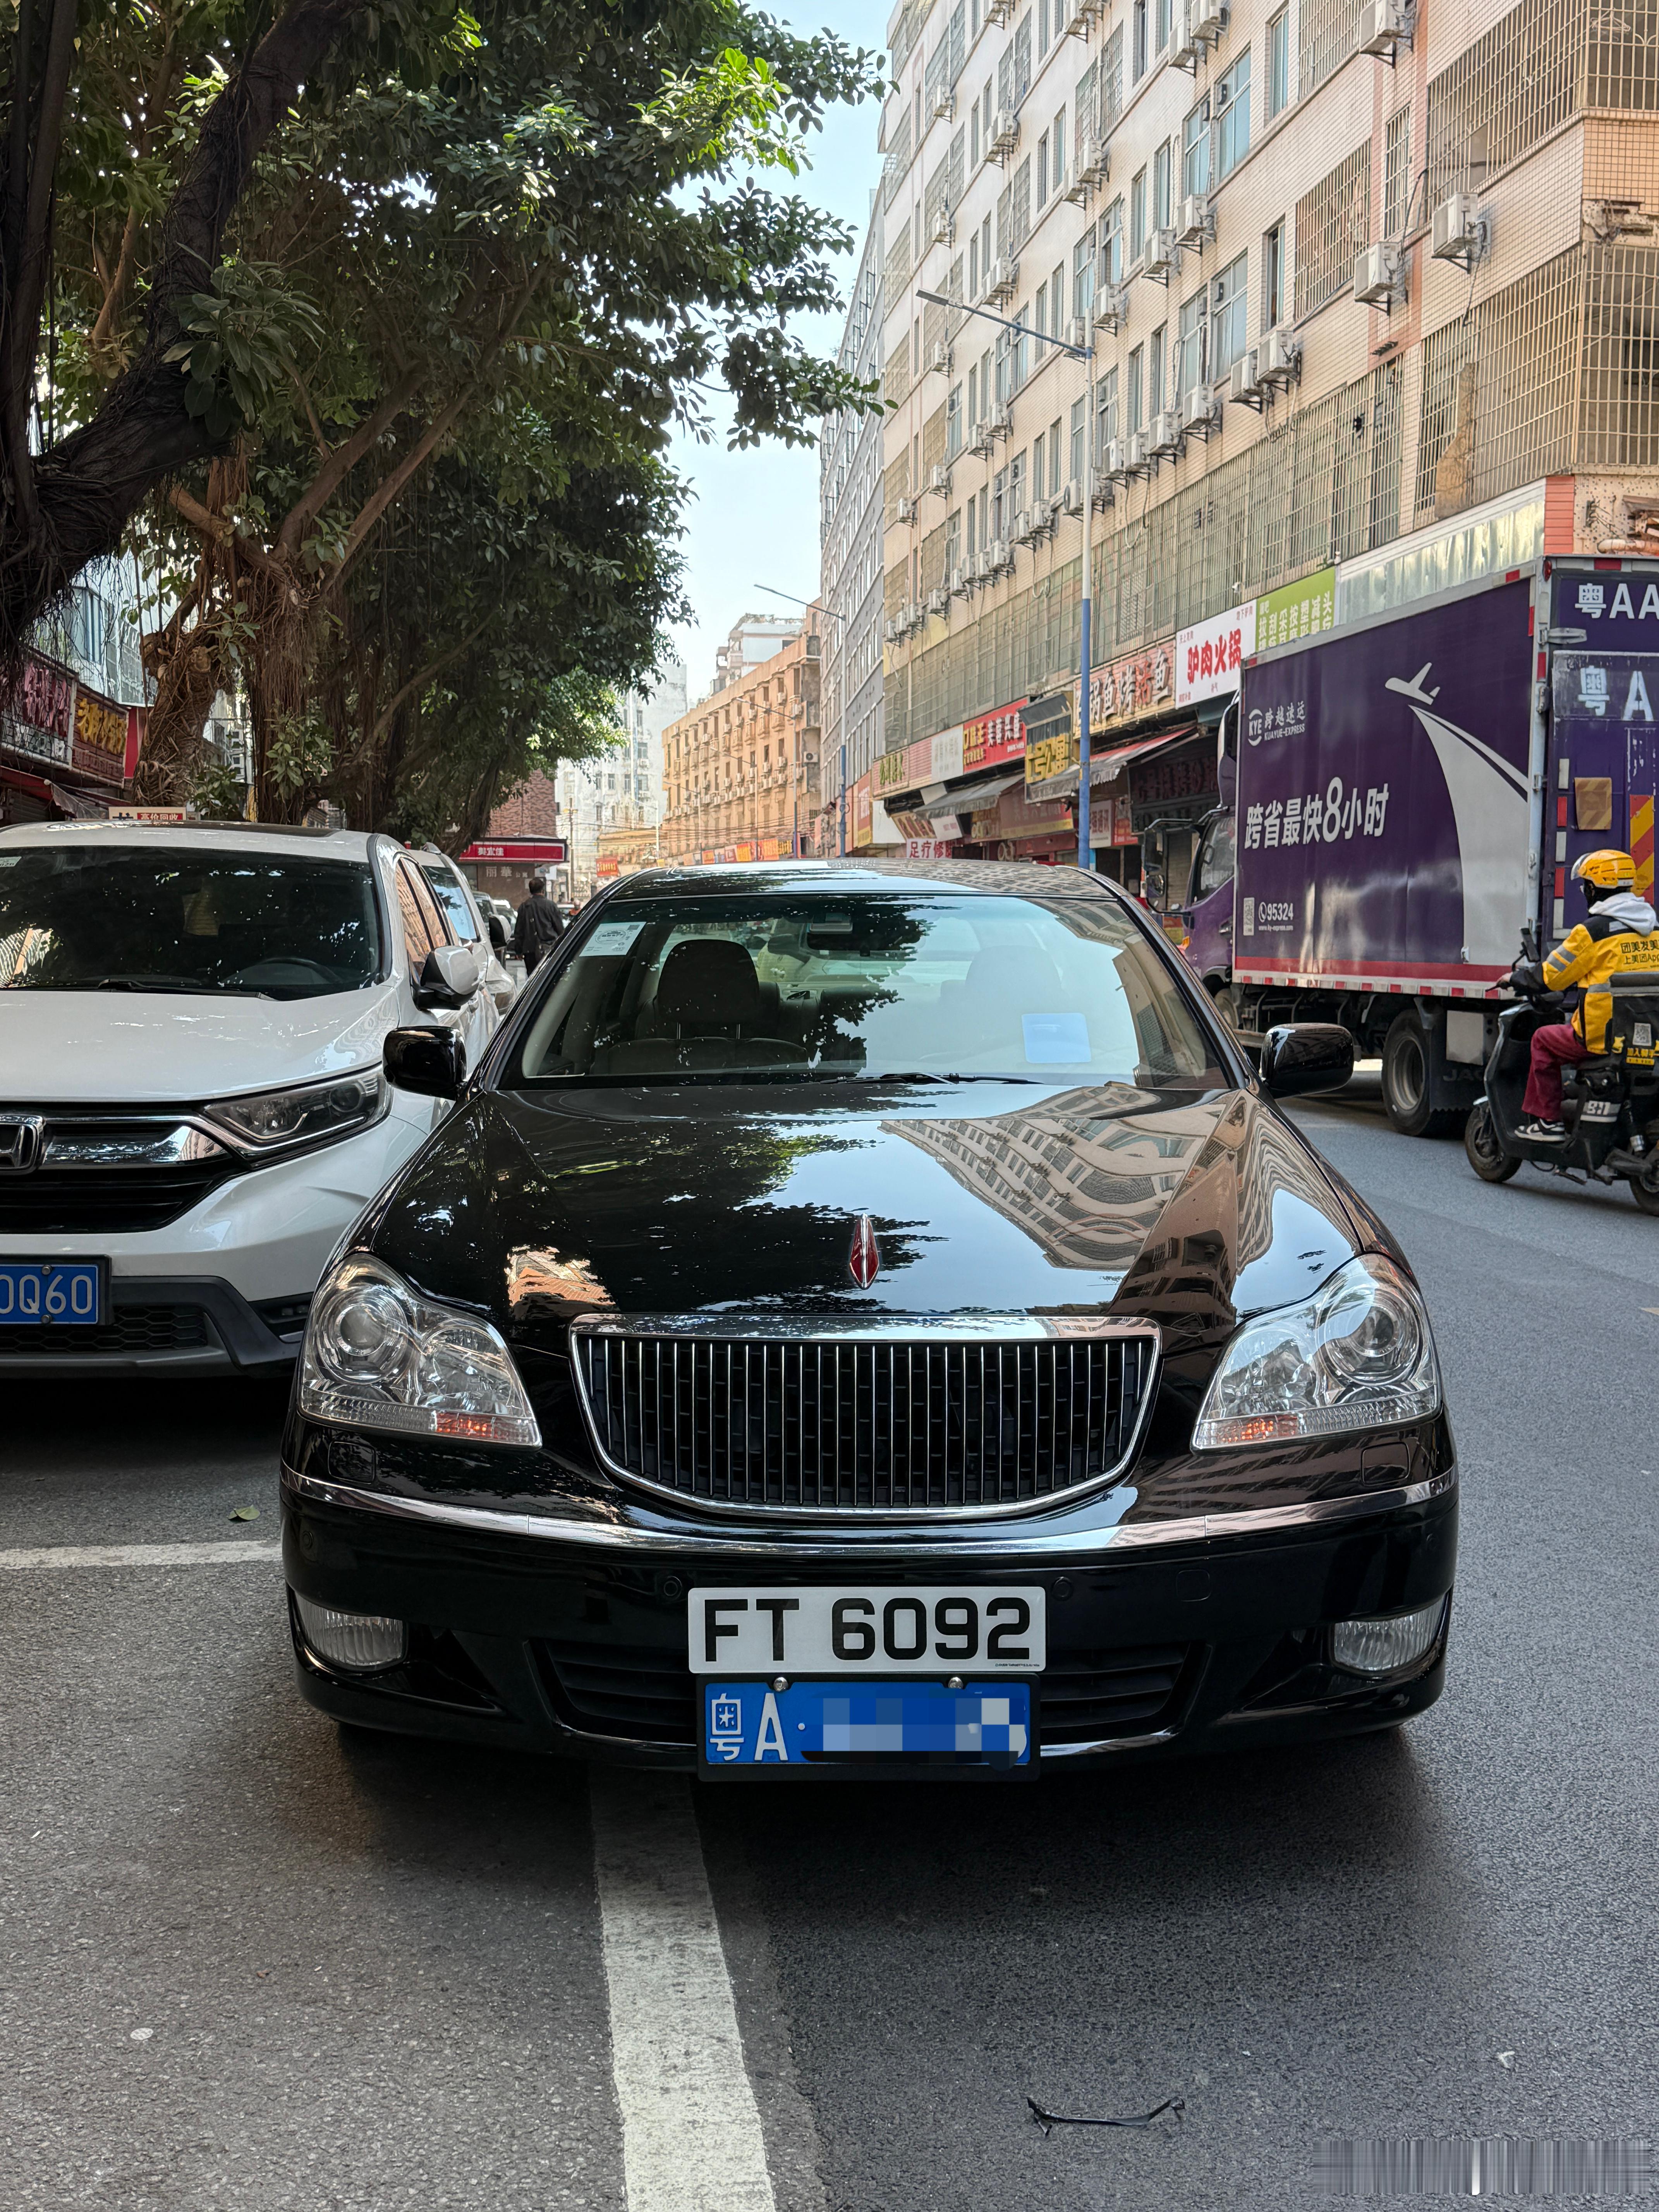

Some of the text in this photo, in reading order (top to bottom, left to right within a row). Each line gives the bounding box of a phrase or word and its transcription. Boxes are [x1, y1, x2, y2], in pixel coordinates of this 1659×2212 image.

[1187, 628, 1241, 684] 驴肉火锅
[1249, 718, 1262, 736] KYE
[1264, 700, 1306, 730] 跨越速运
[1244, 776, 1389, 849] 跨省最快8小时
[1267, 902, 1293, 921] 95324
[704, 1597, 1030, 1662] FT 6092
